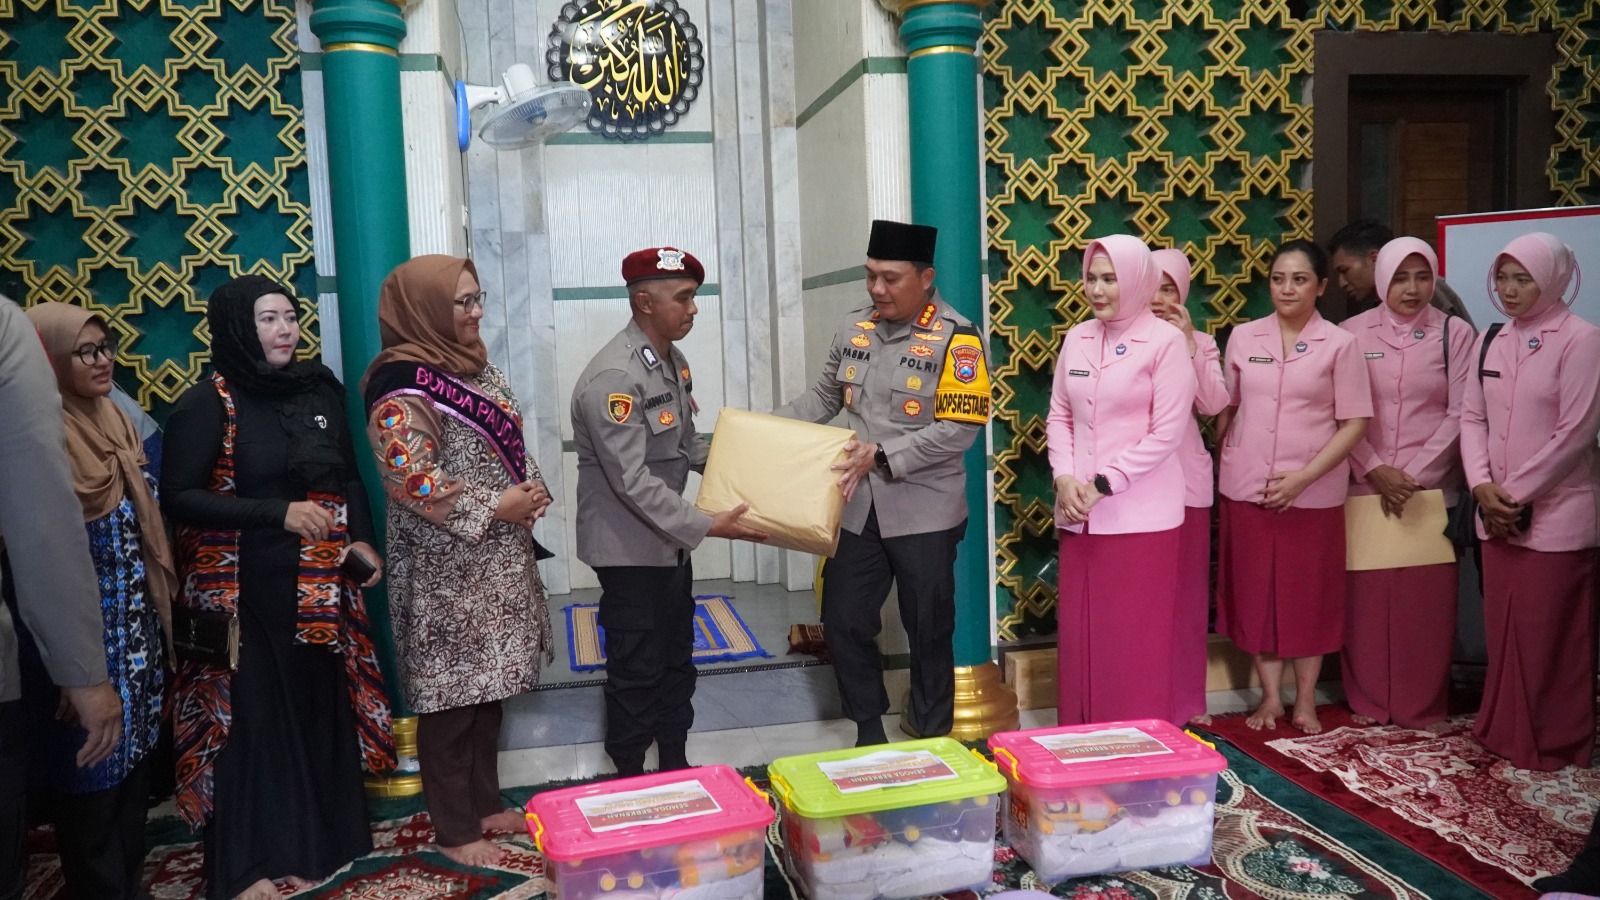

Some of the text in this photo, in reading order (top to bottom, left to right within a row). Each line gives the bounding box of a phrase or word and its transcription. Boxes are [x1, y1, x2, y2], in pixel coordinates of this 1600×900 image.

[842, 347, 871, 362] PASMA
[899, 356, 938, 373] POLRI
[415, 367, 474, 414] BUNDA
[850, 773, 893, 783] BERKENAN
[607, 808, 652, 819] BERKENAN
[653, 802, 689, 812] SEMOGA
